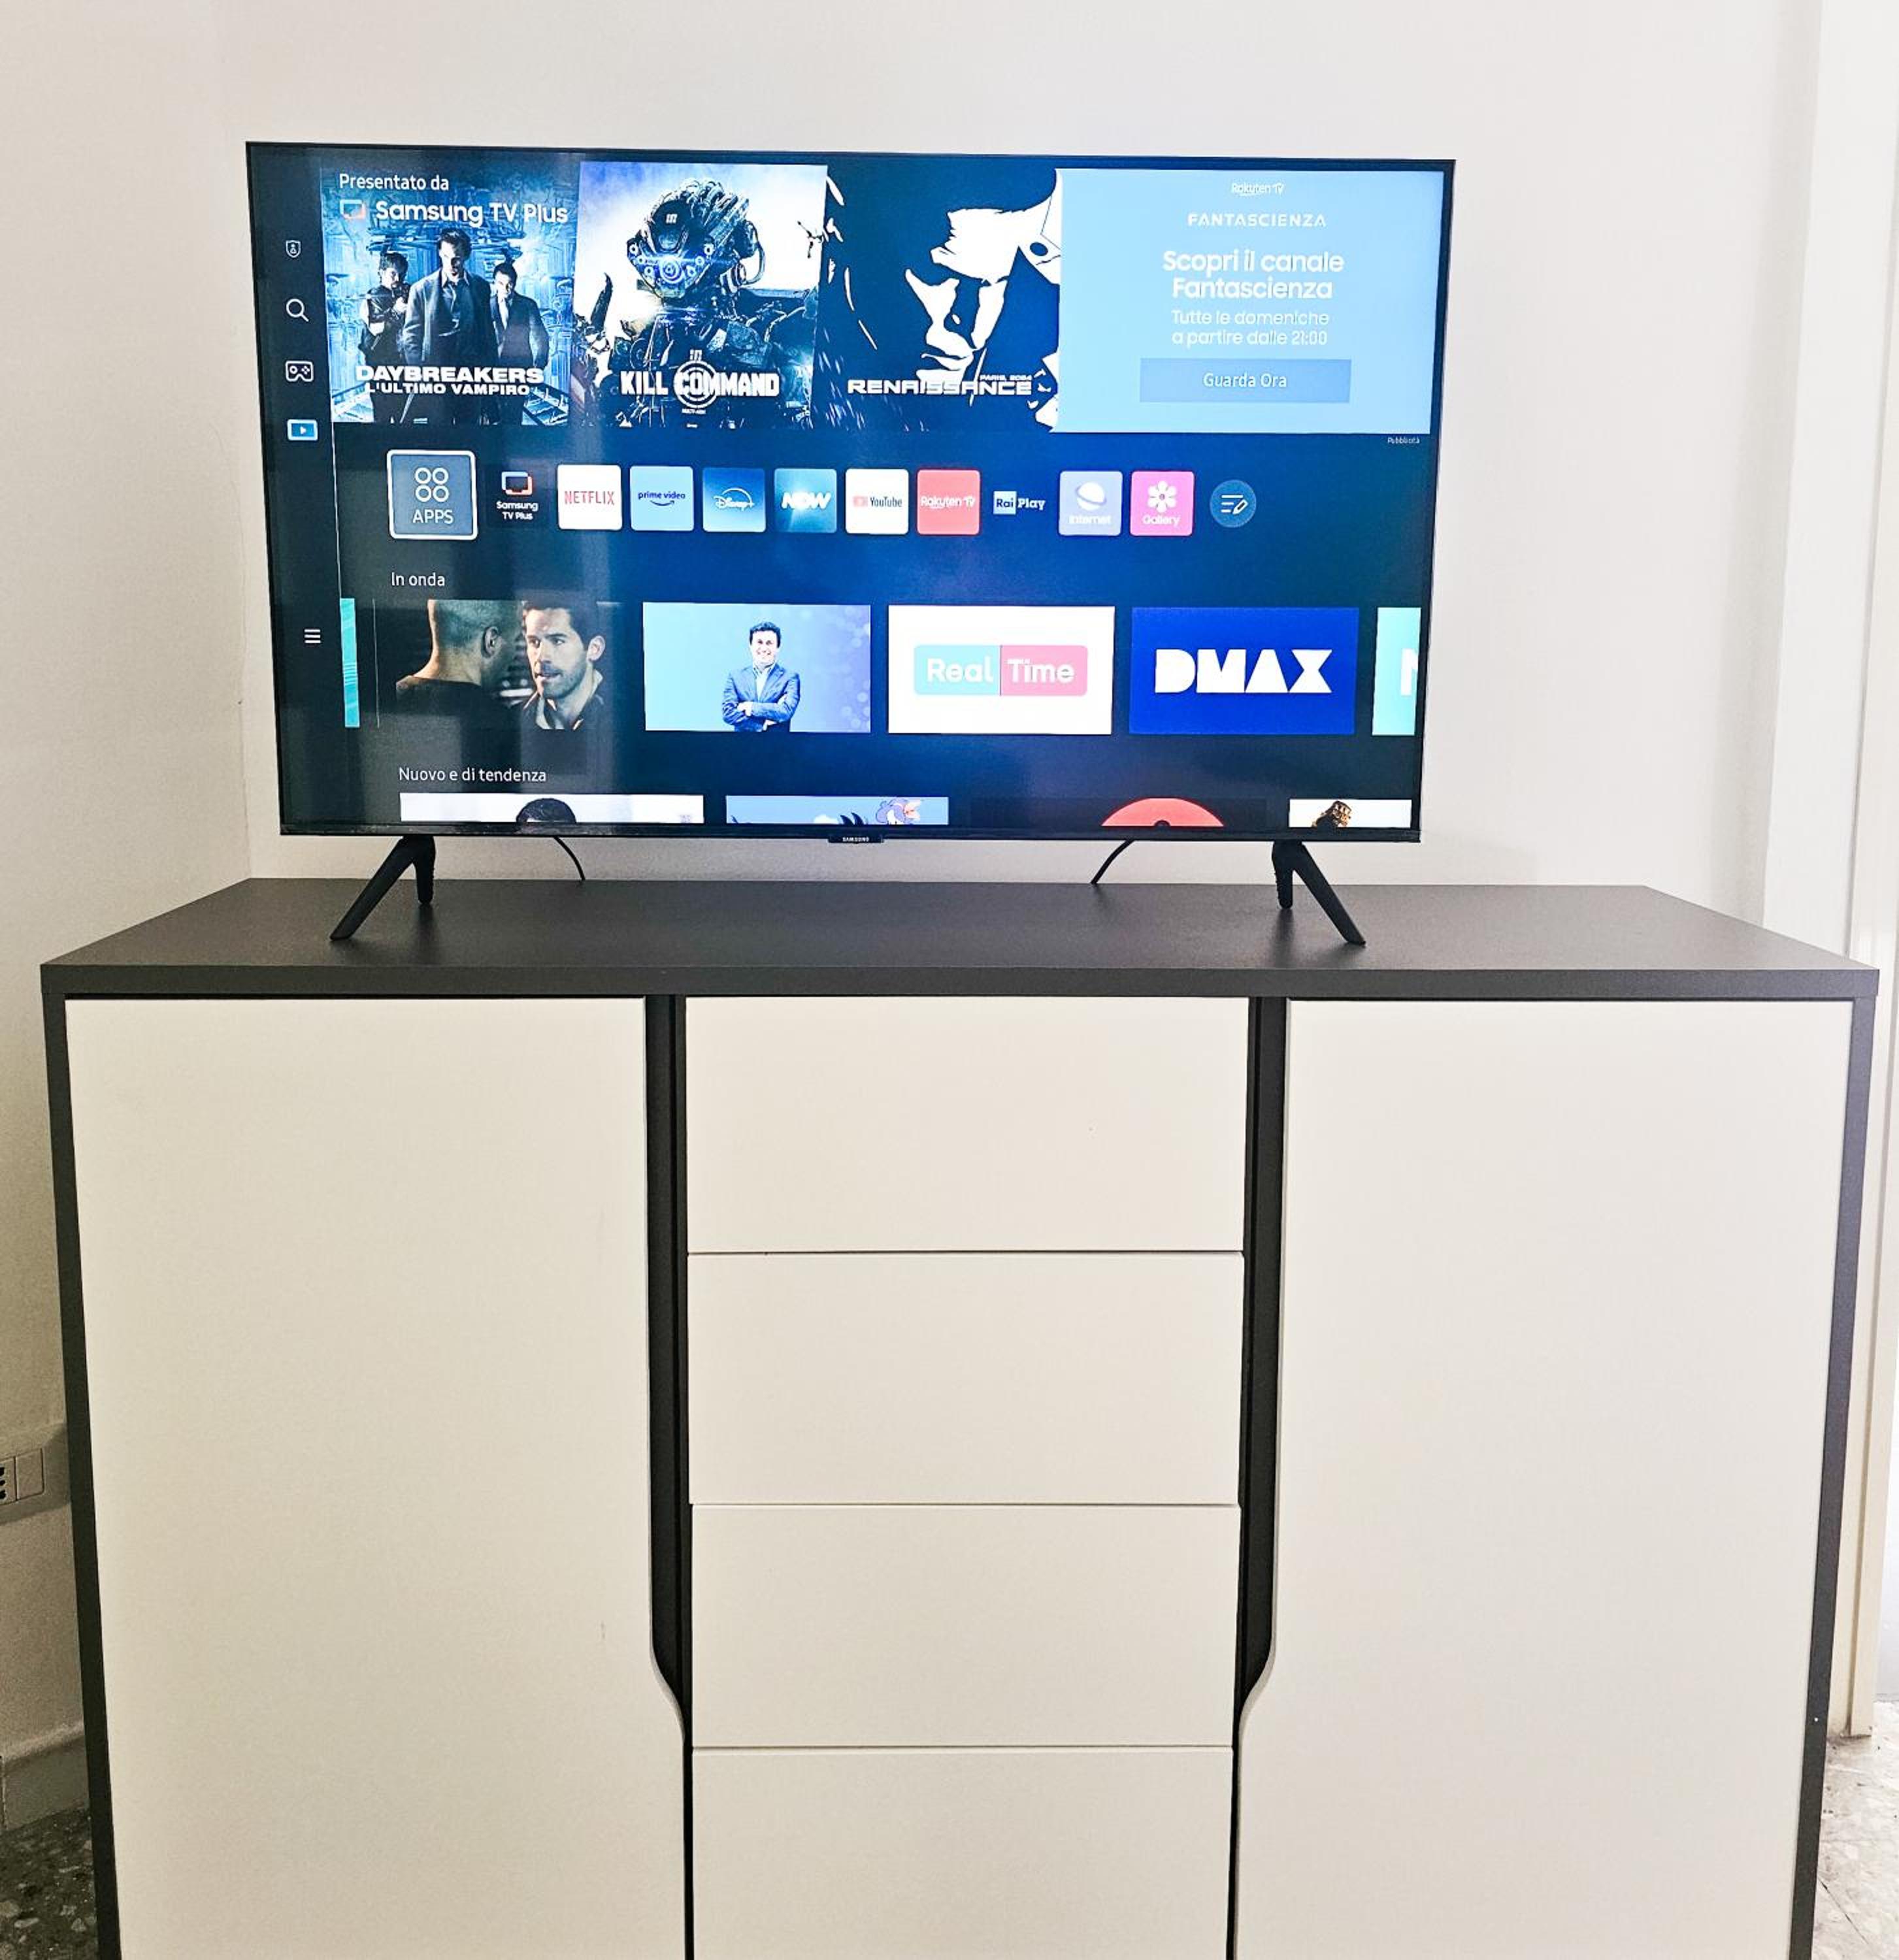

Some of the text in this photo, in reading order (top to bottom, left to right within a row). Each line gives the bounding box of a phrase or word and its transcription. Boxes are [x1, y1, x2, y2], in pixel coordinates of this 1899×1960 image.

[339, 173, 449, 190] Presentato da
[376, 201, 568, 227] Samsung TV Plus
[1187, 213, 1326, 227] FANTASCIENZA
[1163, 250, 1345, 277] Scopri il canale
[1172, 276, 1332, 299] Fantascienza
[1172, 310, 1329, 325] Tutte le domeniche
[1172, 331, 1327, 348] a partire dalle 21:00
[355, 365, 544, 383] DAYBREAKERS
[1203, 373, 1287, 387] Guarda Ora
[365, 382, 530, 395] L'ULTIMO VAMPIRO
[621, 370, 780, 397] KILL COMMAND
[848, 380, 1032, 395] RENAISSANCE
[564, 491, 615, 506] NETFLIX
[638, 491, 662, 500] prime
[781, 492, 831, 509] NOW
[870, 497, 902, 508] YouTube
[921, 496, 962, 509] Rakuten
[496, 500, 538, 512] Samsung
[996, 498, 1046, 511] Rai Play
[412, 509, 454, 524] APPS
[1069, 514, 1112, 525] Internet
[1142, 514, 1180, 527] Gallery
[391, 572, 445, 587] In onda
[927, 657, 1074, 684] Real Time
[1155, 649, 1332, 693] DMAX
[399, 768, 546, 782] Nuovo e di tendenza
